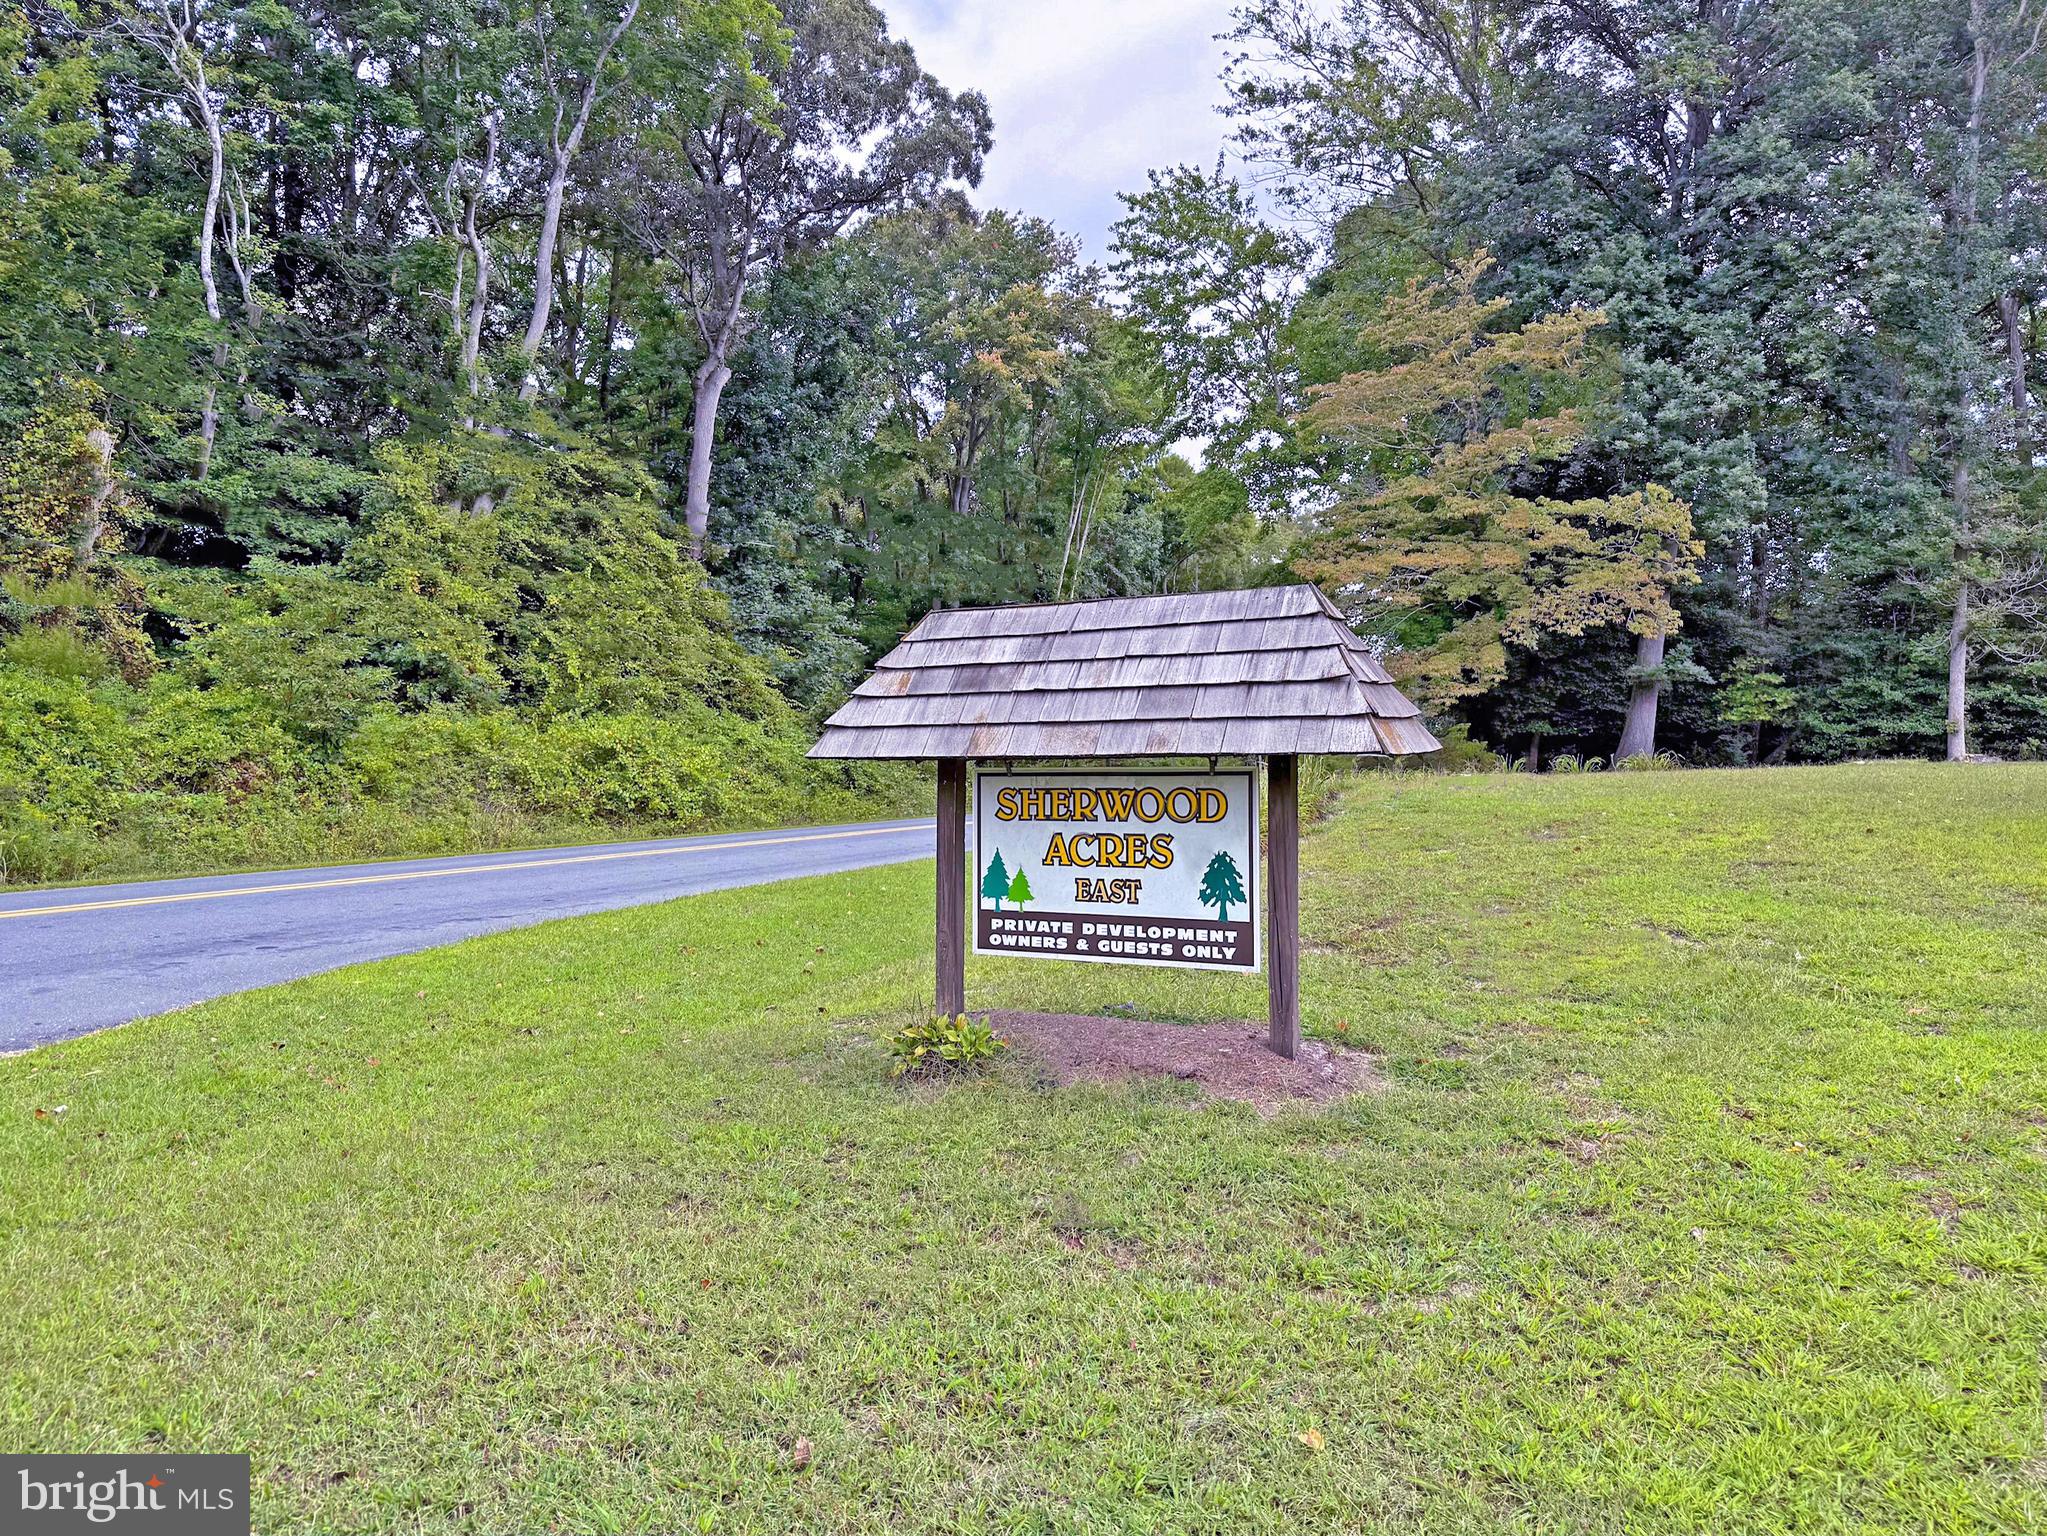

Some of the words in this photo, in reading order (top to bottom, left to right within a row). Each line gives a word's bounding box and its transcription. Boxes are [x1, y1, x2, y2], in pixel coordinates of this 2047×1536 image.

[995, 787, 1228, 823] SHERWOOD
[1042, 832, 1174, 869] ACRES
[1075, 878, 1142, 904] EAST
[991, 918, 1073, 934] PRIVATE
[1082, 922, 1238, 943] DEVELOPMENT
[989, 934, 1068, 950] OWNERS
[1076, 939, 1089, 951] &
[1097, 939, 1174, 956] GUESTS
[1182, 945, 1236, 960] ONLY
